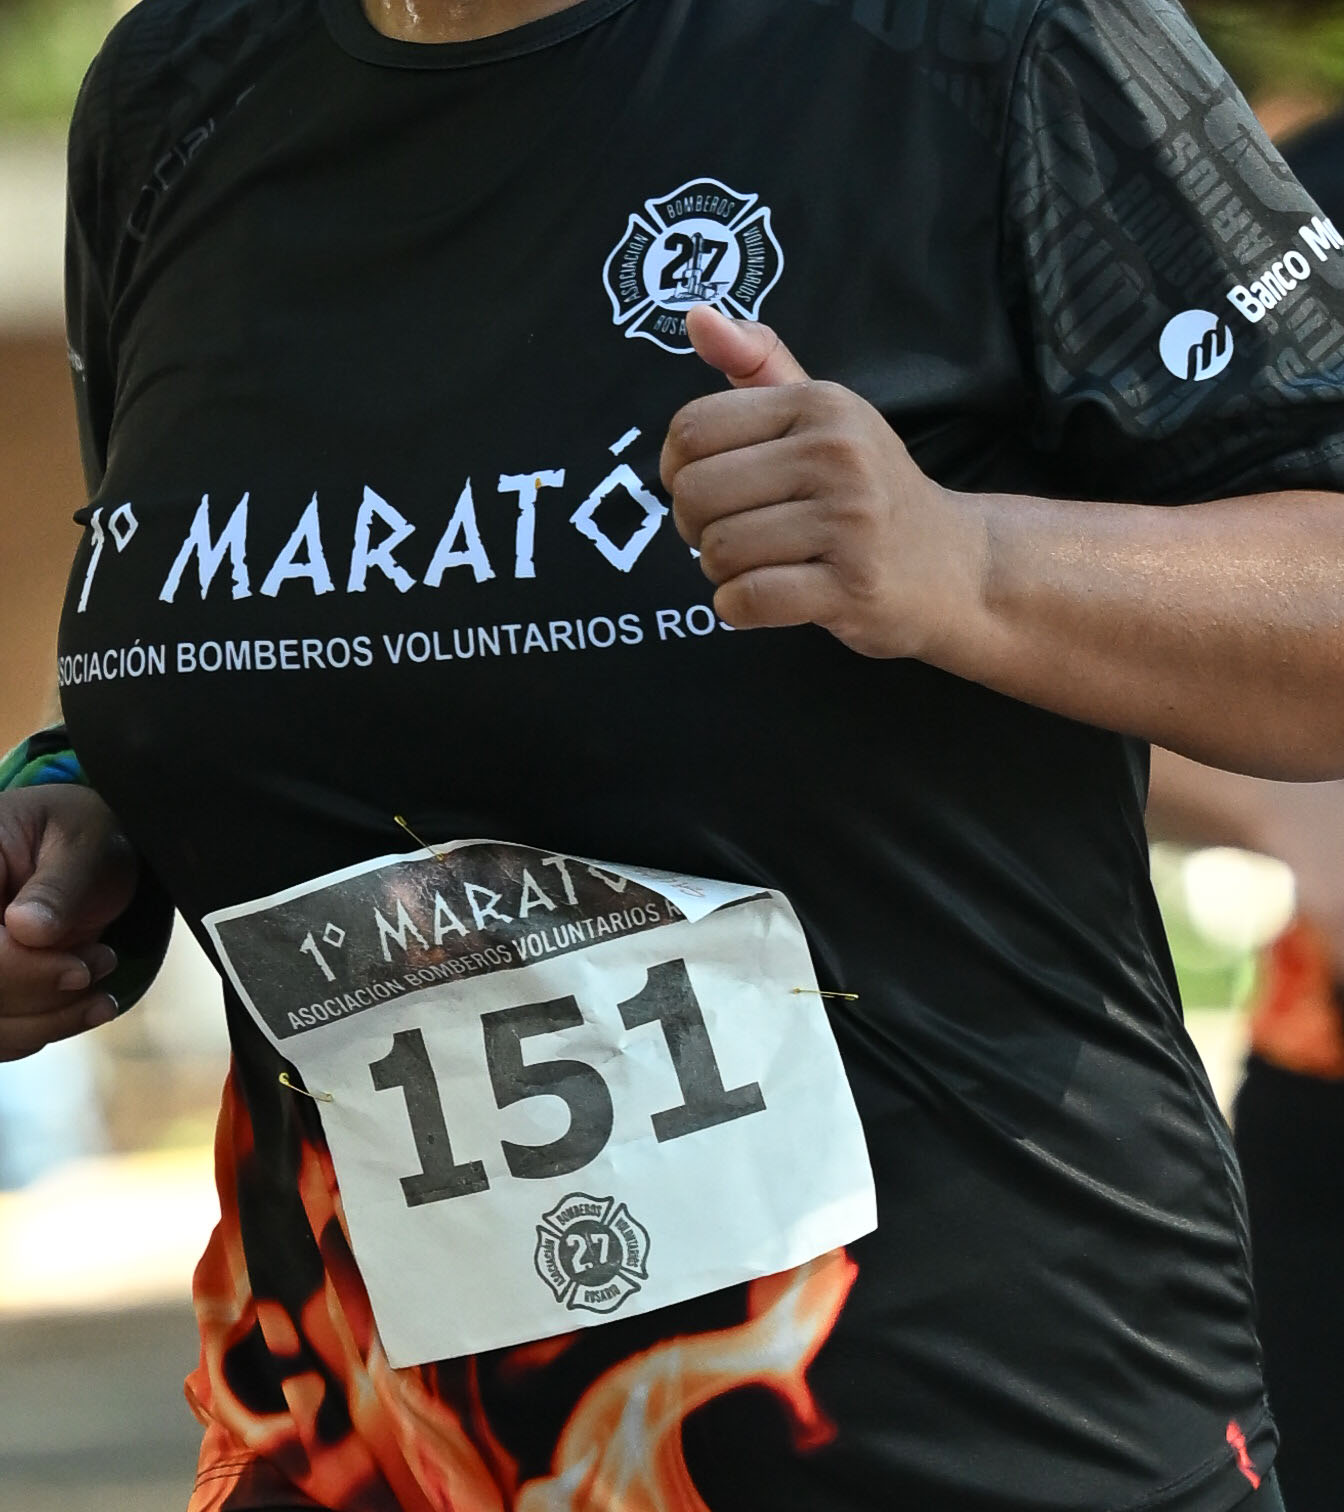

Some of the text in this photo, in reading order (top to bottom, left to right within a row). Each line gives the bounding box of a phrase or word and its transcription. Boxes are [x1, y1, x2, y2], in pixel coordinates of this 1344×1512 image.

[665, 194, 736, 219] BOMBEROS
[659, 231, 729, 291] 27
[734, 225, 765, 303] VOLUNTARIOS
[1225, 249, 1312, 324] Banco
[653, 313, 689, 336] ROSA
[158, 426, 702, 605] MARATÓ
[58, 604, 736, 687] SOCIACIÓN BOMBEROS VOLUNTARIOS RO
[405, 944, 513, 988] BOMBEROS
[511, 902, 661, 962] VOLUNTARIOS
[367, 957, 768, 1208] 151
[565, 1232, 610, 1275] 27
